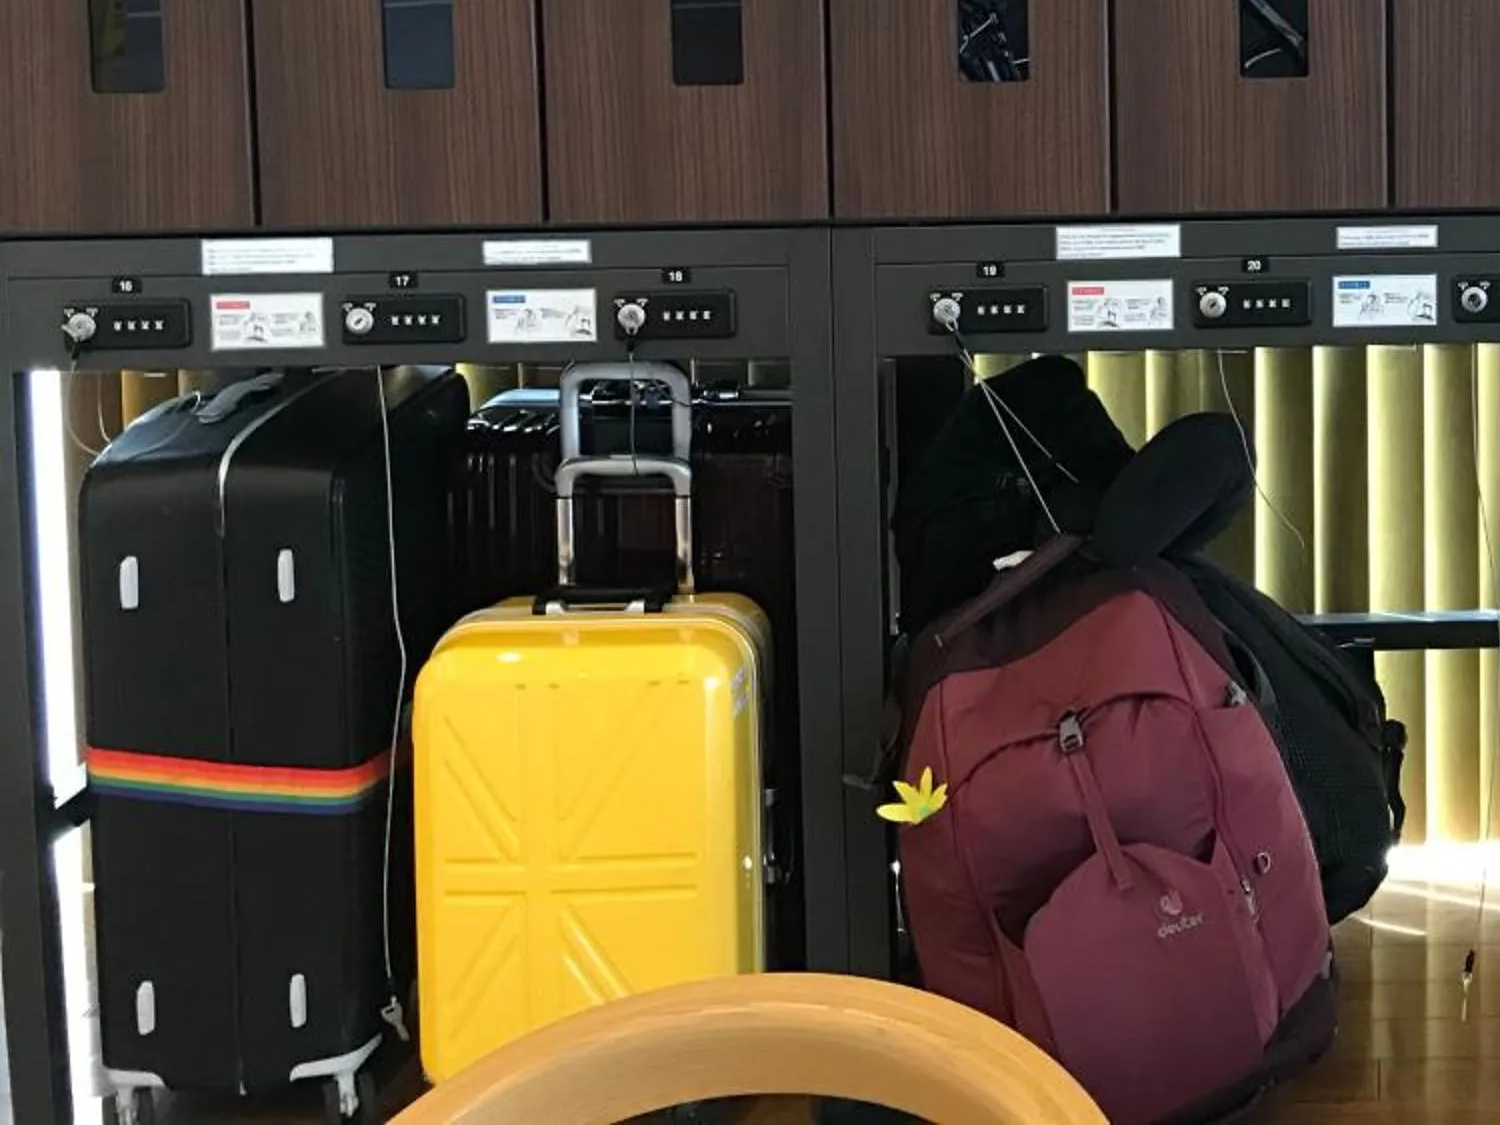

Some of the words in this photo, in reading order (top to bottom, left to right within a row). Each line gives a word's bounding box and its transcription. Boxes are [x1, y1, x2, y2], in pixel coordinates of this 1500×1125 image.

[1247, 260, 1262, 271] 20
[119, 280, 133, 292] 16
[396, 275, 410, 286] 17
